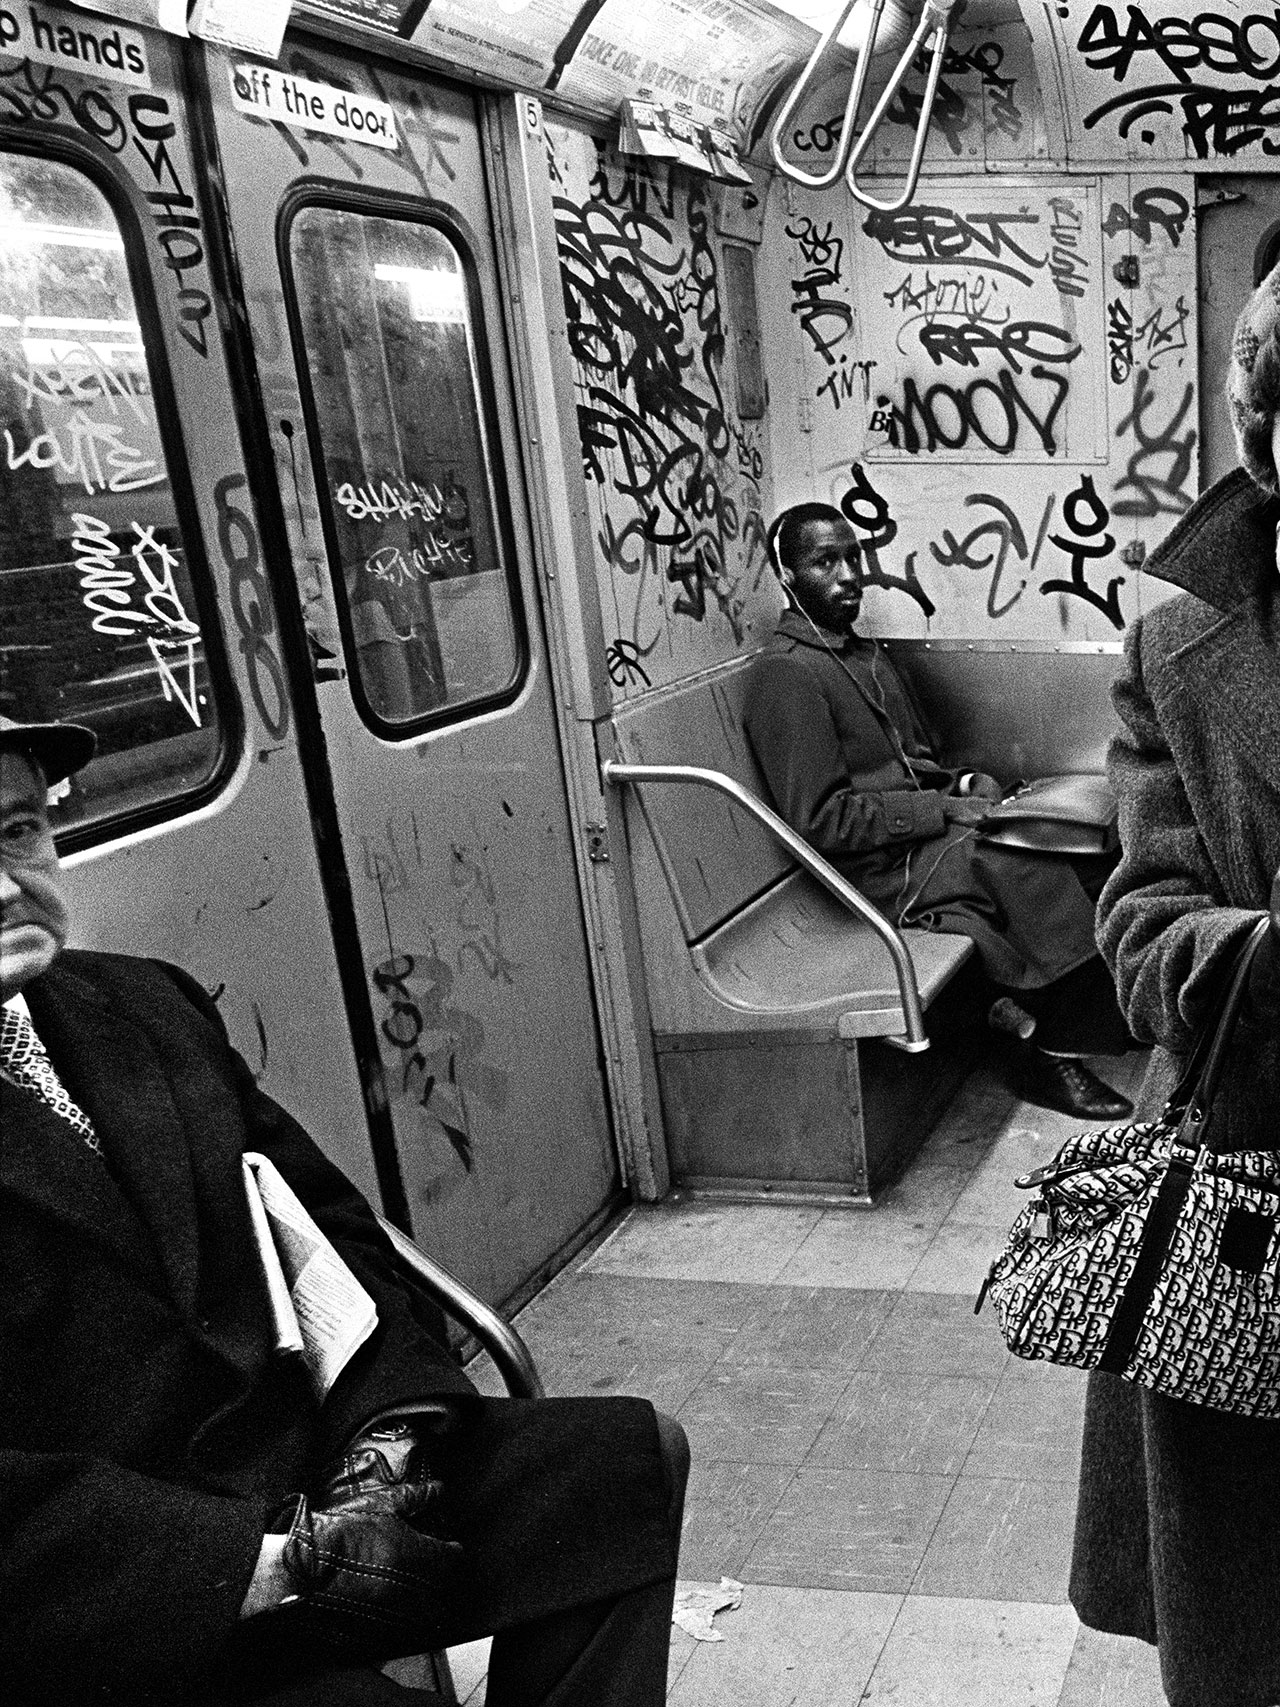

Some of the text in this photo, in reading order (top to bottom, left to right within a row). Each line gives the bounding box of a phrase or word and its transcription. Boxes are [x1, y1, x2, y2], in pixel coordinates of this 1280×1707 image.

[29, 6, 145, 74] hands
[282, 78, 325, 119] the
[527, 103, 537, 127] 5
